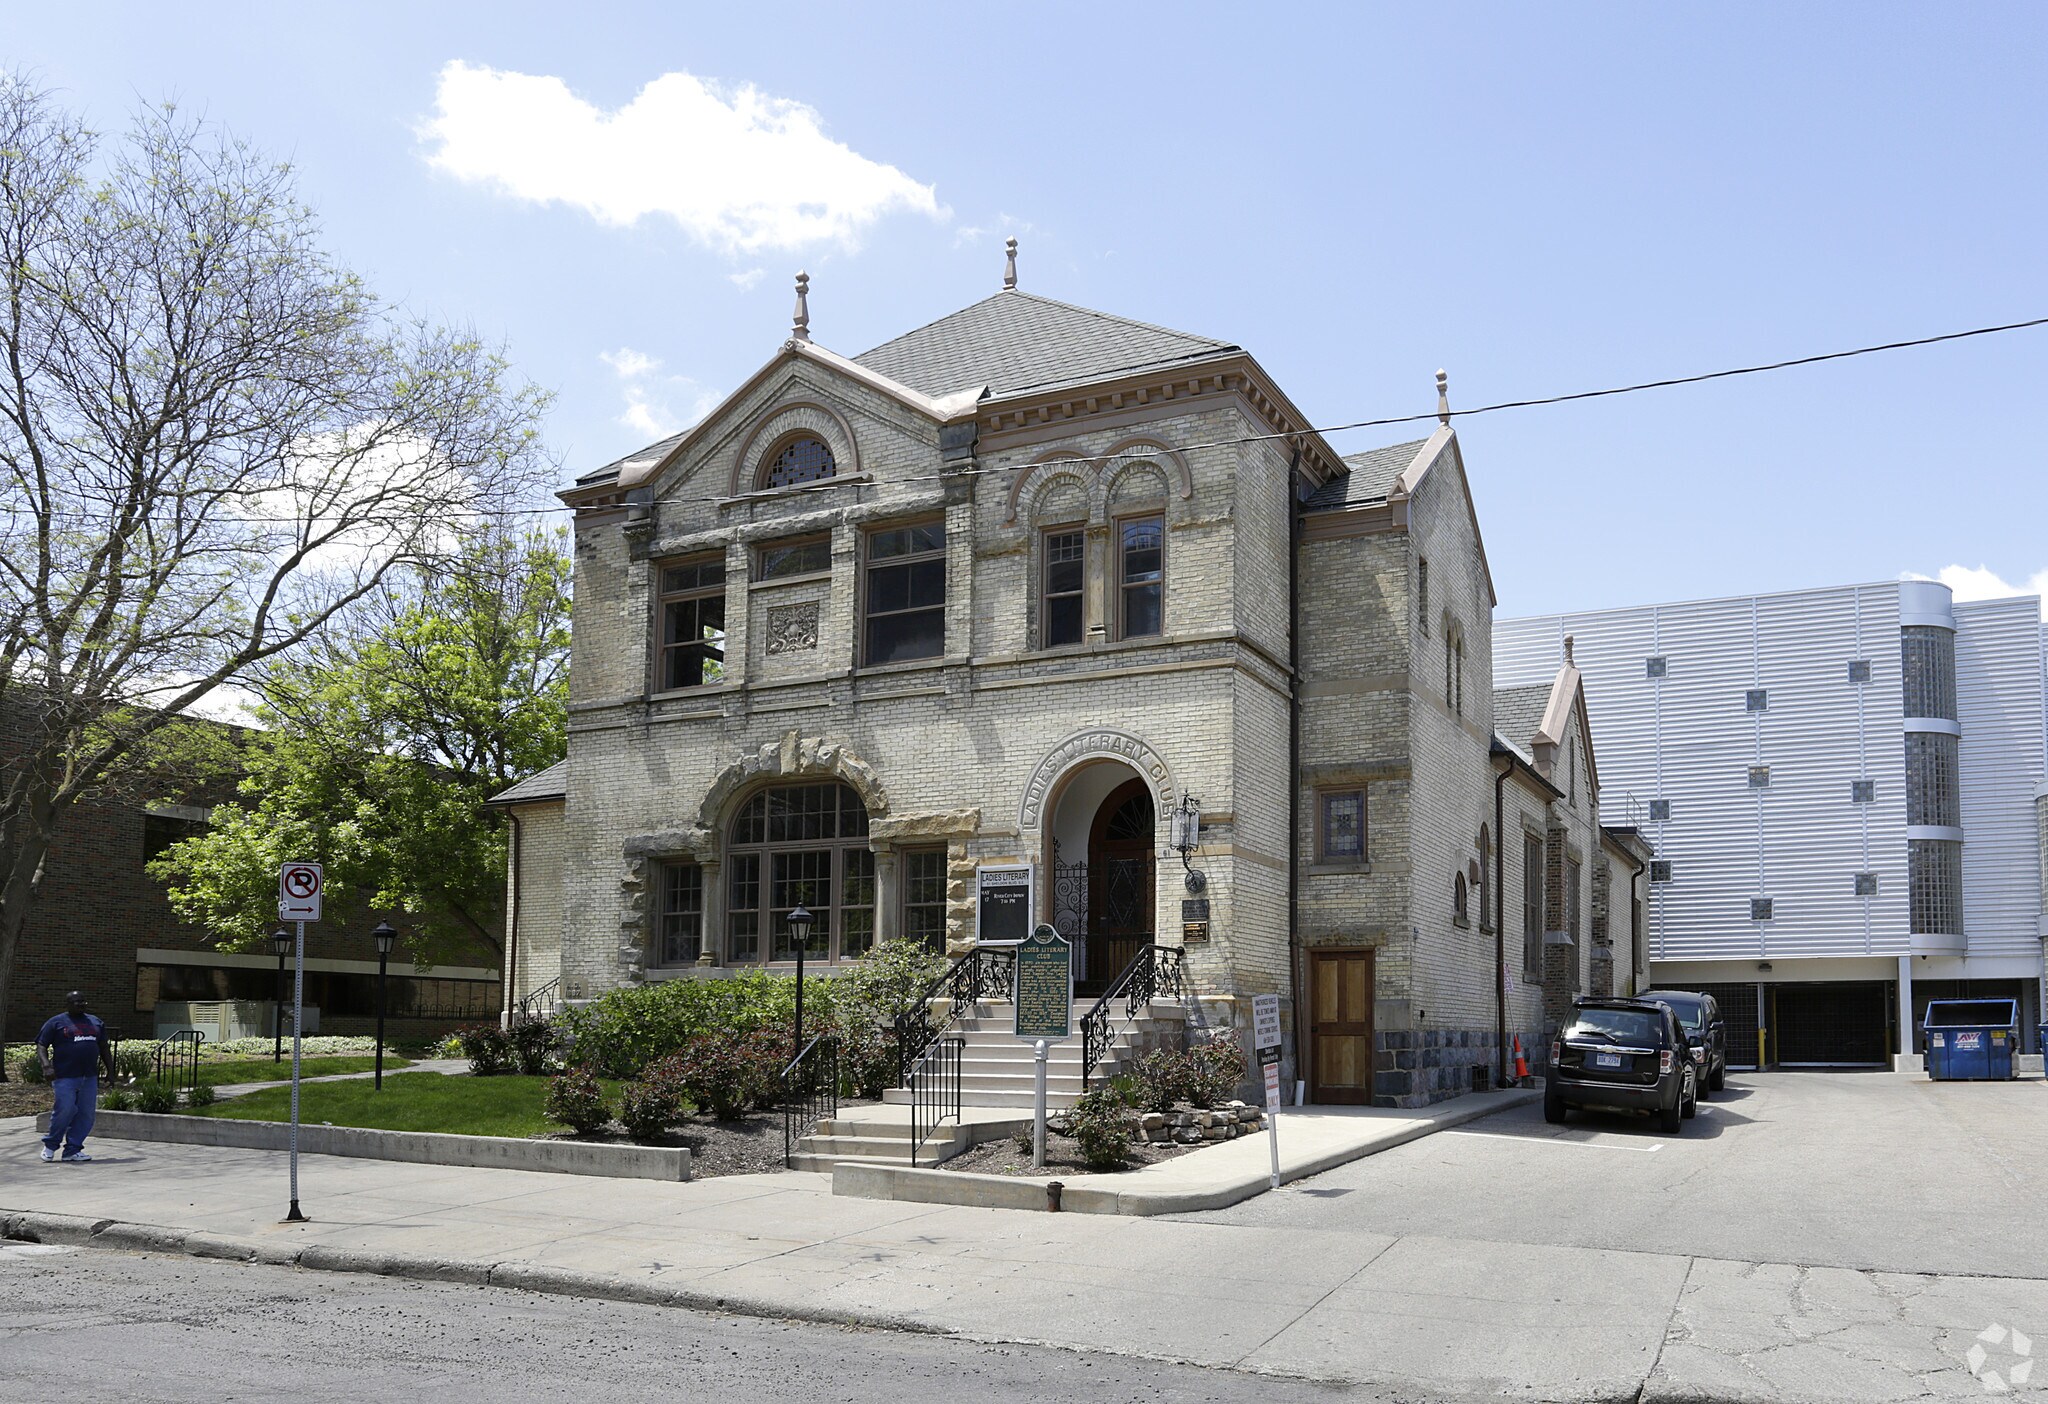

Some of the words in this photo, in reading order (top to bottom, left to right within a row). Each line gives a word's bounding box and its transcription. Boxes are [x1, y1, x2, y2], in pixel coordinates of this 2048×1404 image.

[1061, 734, 1149, 761] LITERARY
[1150, 763, 1176, 816] CLUB
[982, 873, 1002, 882] LADIES
[1003, 872, 1029, 881] LITERARY
